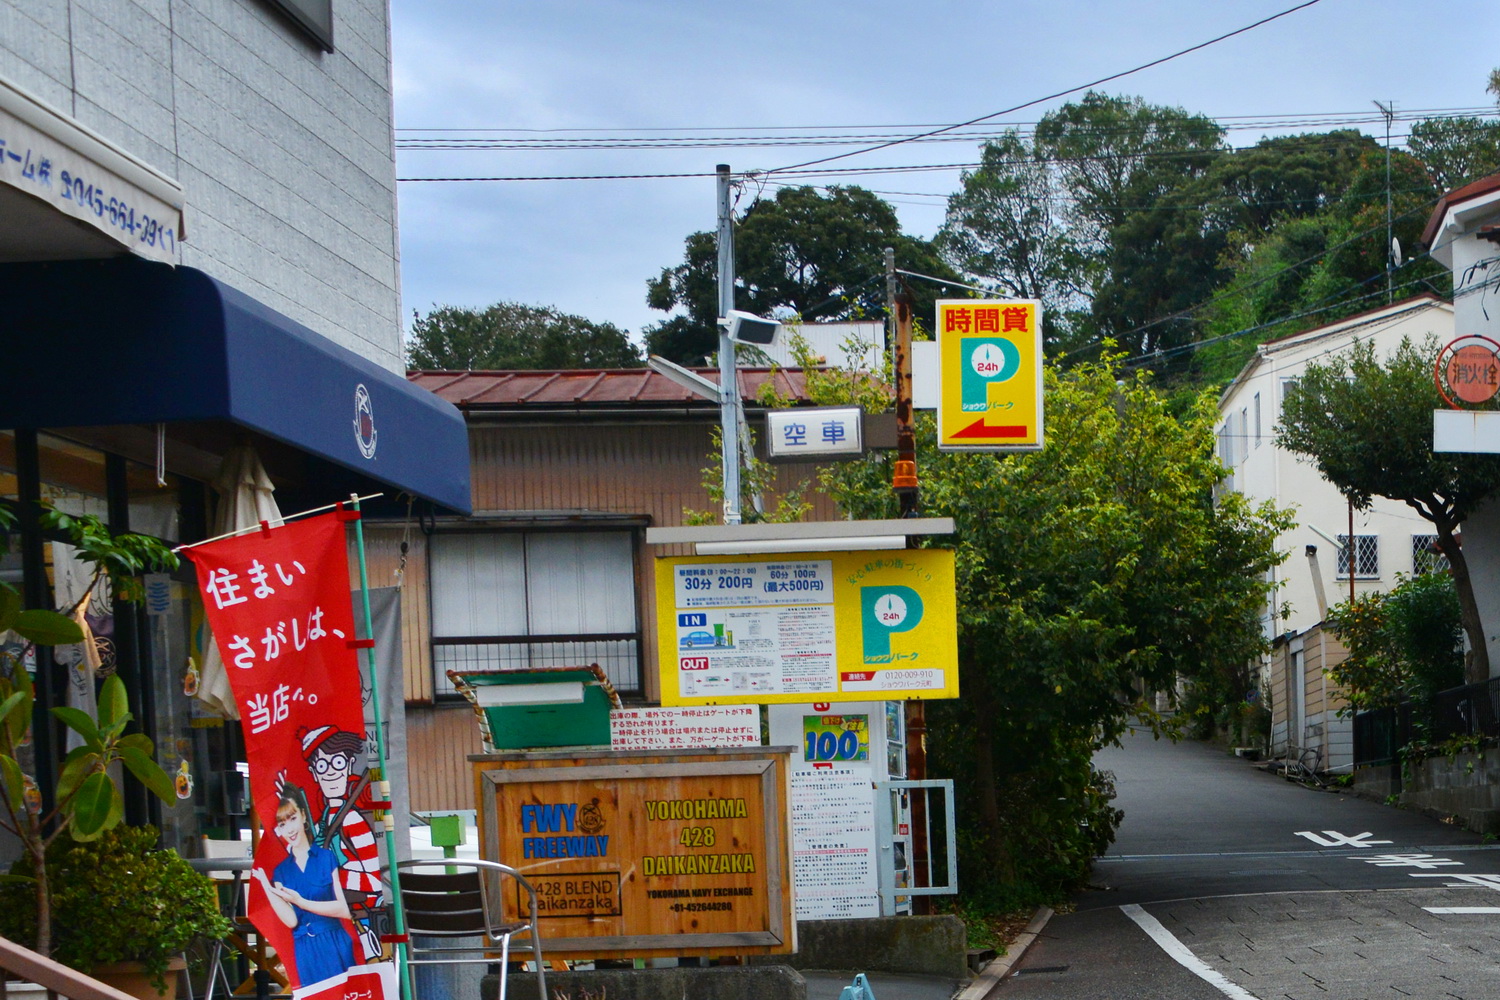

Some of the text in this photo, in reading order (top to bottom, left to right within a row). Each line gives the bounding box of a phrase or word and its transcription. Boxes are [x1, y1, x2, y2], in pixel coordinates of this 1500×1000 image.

[946, 307, 1029, 333] 時間貸
[977, 363, 999, 372] 24h
[1452, 363, 1498, 385] 消火栓
[783, 420, 846, 446] 空車
[206, 559, 306, 609] 住まい
[685, 576, 753, 590] 30分 200円
[770, 569, 816, 579] 60分 100円
[684, 615, 700, 626] IN
[883, 613, 900, 621] 24h
[681, 659, 707, 670] OUT
[885, 671, 933, 680] 0120-009-910
[806, 730, 859, 760] 100
[521, 803, 578, 833] FWY
[646, 798, 748, 821] YOKOHAMA
[523, 834, 609, 859] FREEWAY
[680, 826, 716, 848] 428
[643, 852, 756, 877] DAIKANZAKA
[565, 880, 613, 895] BLEND
[646, 887, 753, 899] YOKOHAMA NAVY EXCHANGE
